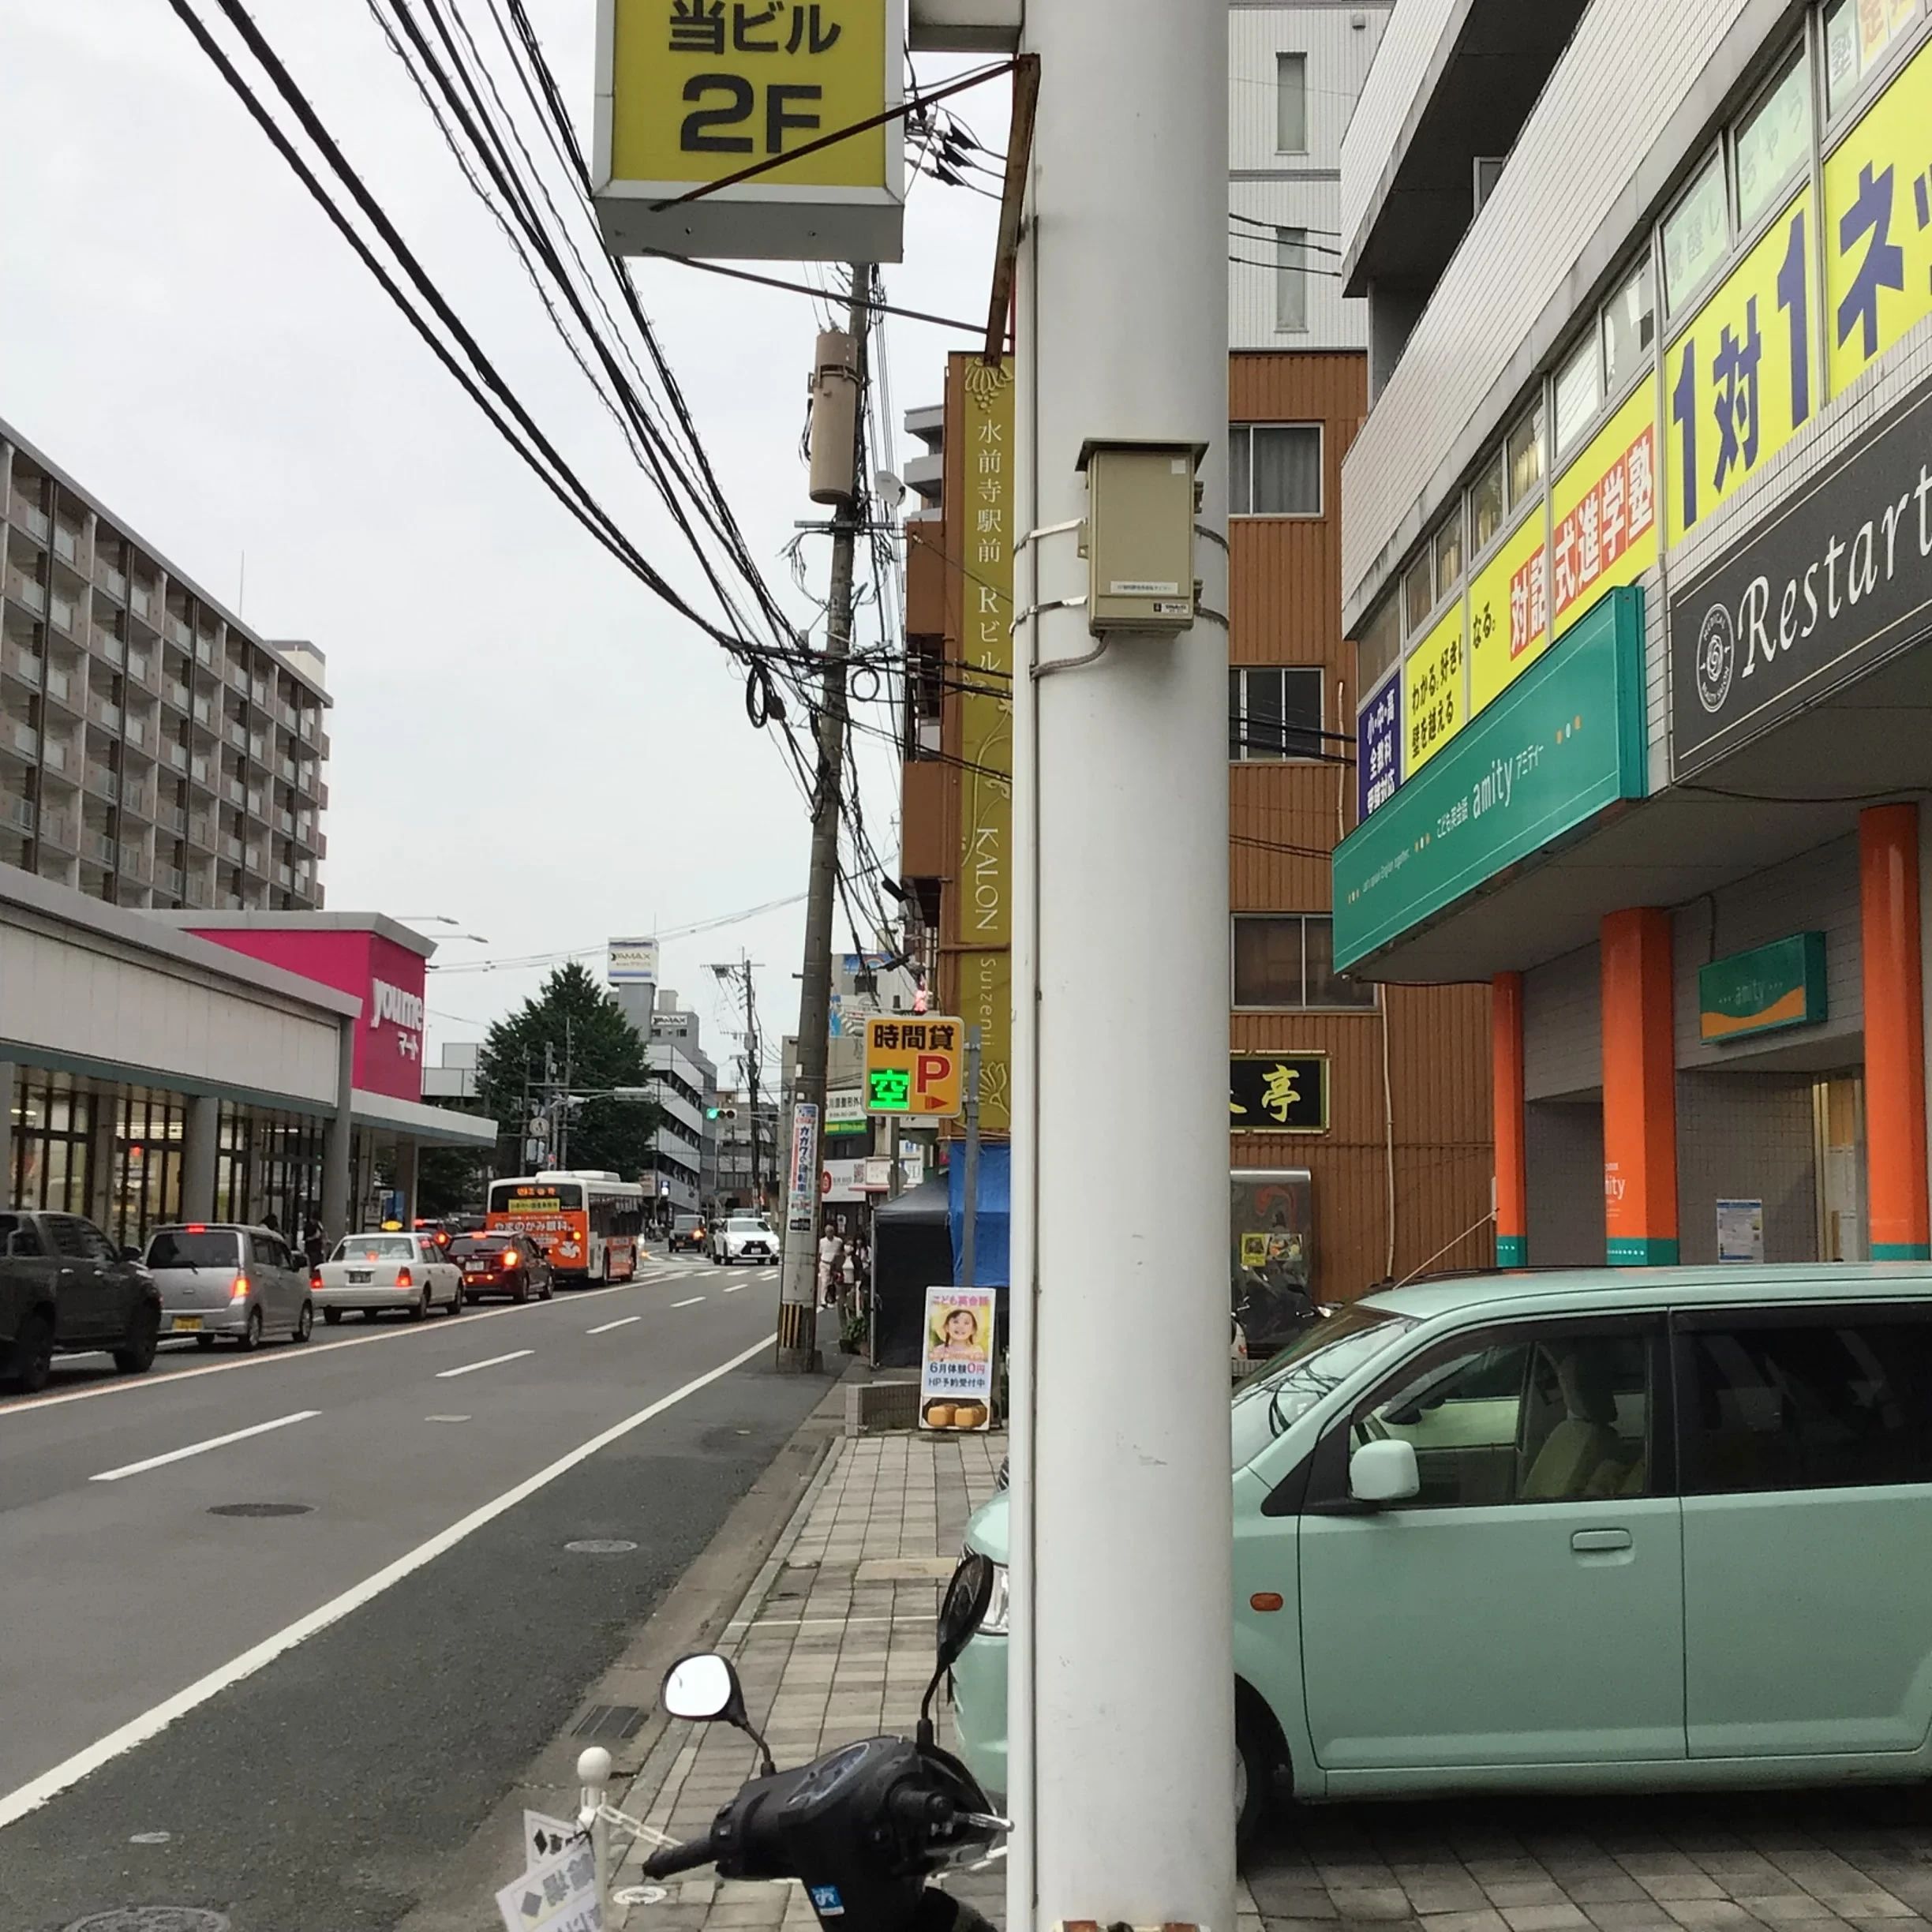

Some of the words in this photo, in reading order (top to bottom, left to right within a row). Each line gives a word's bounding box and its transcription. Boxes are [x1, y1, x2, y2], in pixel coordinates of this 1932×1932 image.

[669, 0, 841, 54] 当ビル
[680, 73, 822, 153] 2F
[977, 419, 1002, 564] 水前寺駅前
[1738, 464, 1932, 679] Restart
[978, 586, 1002, 672] Rビル
[1473, 758, 1513, 819] amity
[975, 828, 998, 930] KALON
[371, 977, 423, 1032] youme
[398, 1031, 419, 1061] マート
[874, 1024, 954, 1050] 時間貸
[871, 1069, 909, 1109] 空
[916, 1055, 951, 1094] P
